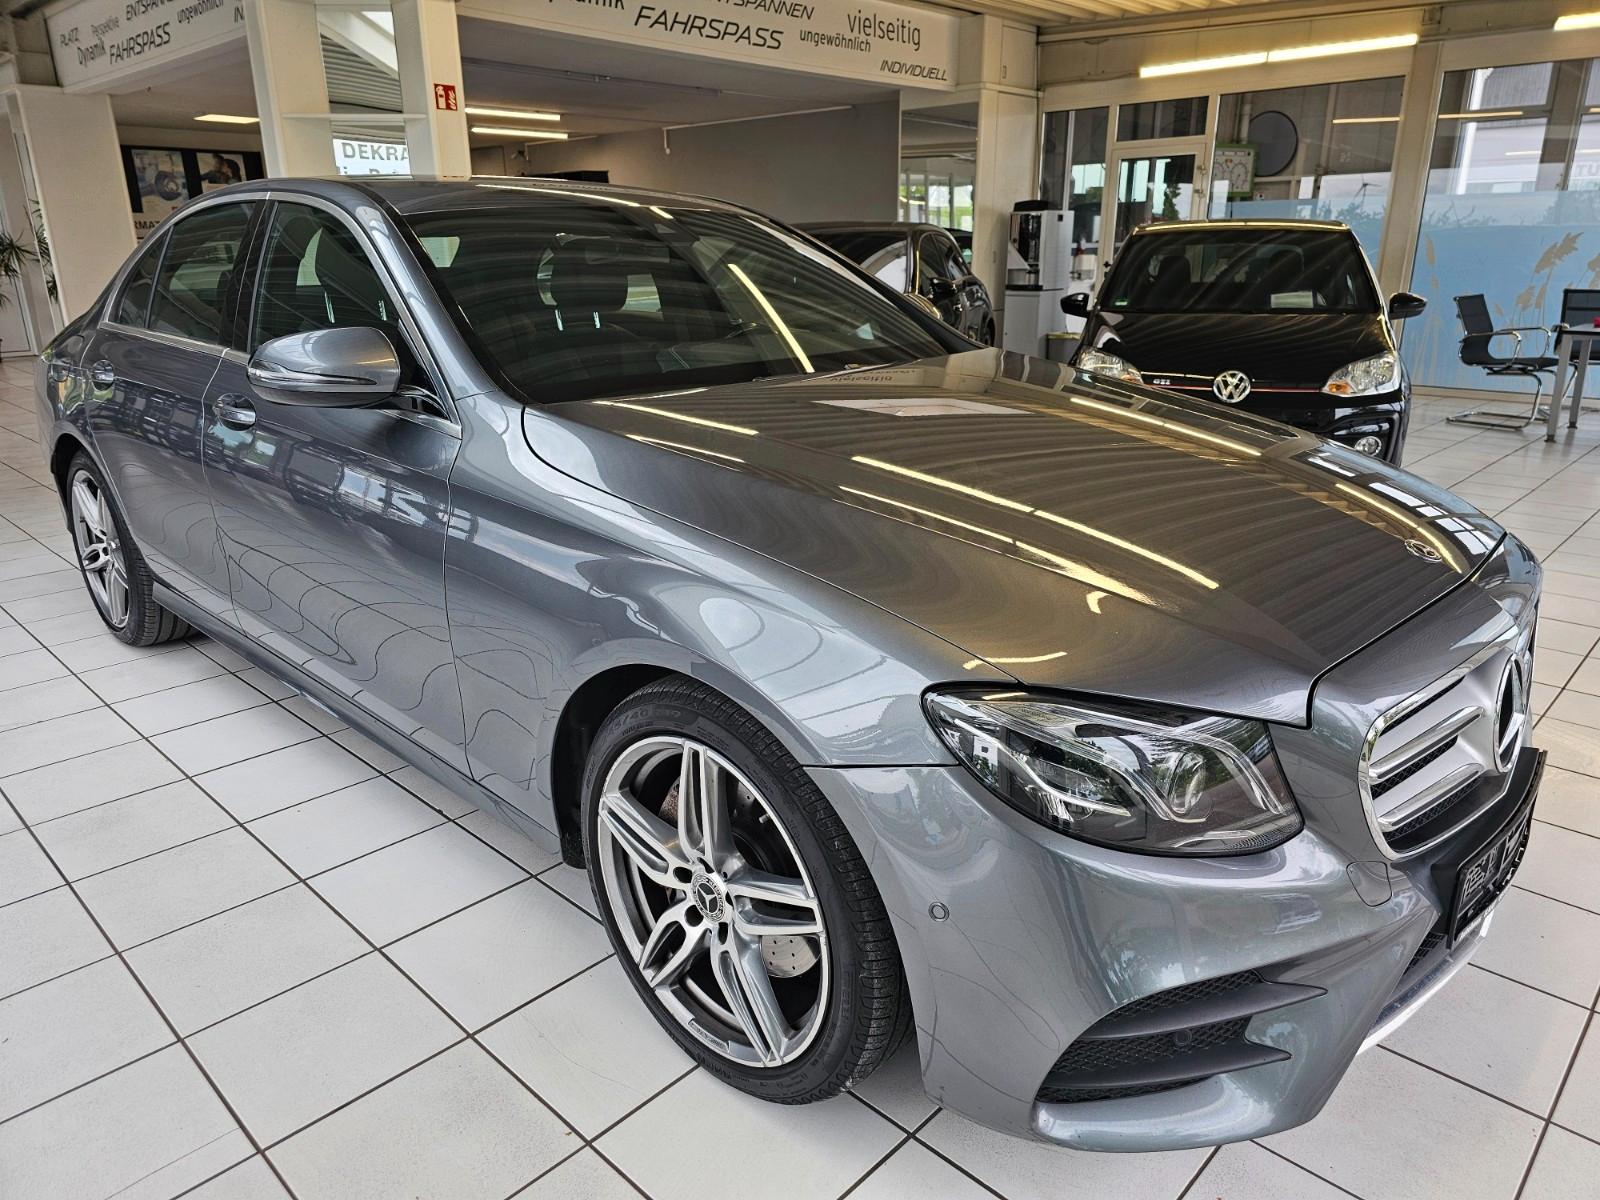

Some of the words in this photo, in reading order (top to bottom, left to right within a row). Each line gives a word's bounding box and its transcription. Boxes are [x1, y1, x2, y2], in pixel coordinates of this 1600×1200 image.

[109, 22, 171, 64] FAHRSPASS
[633, 5, 784, 50] FAHRSPASS
[799, 29, 871, 52] ungewöhnlich
[847, 9, 921, 52] vielseitig
[77, 40, 106, 67] Dynamik
[880, 59, 948, 81] INDIVIDUELL
